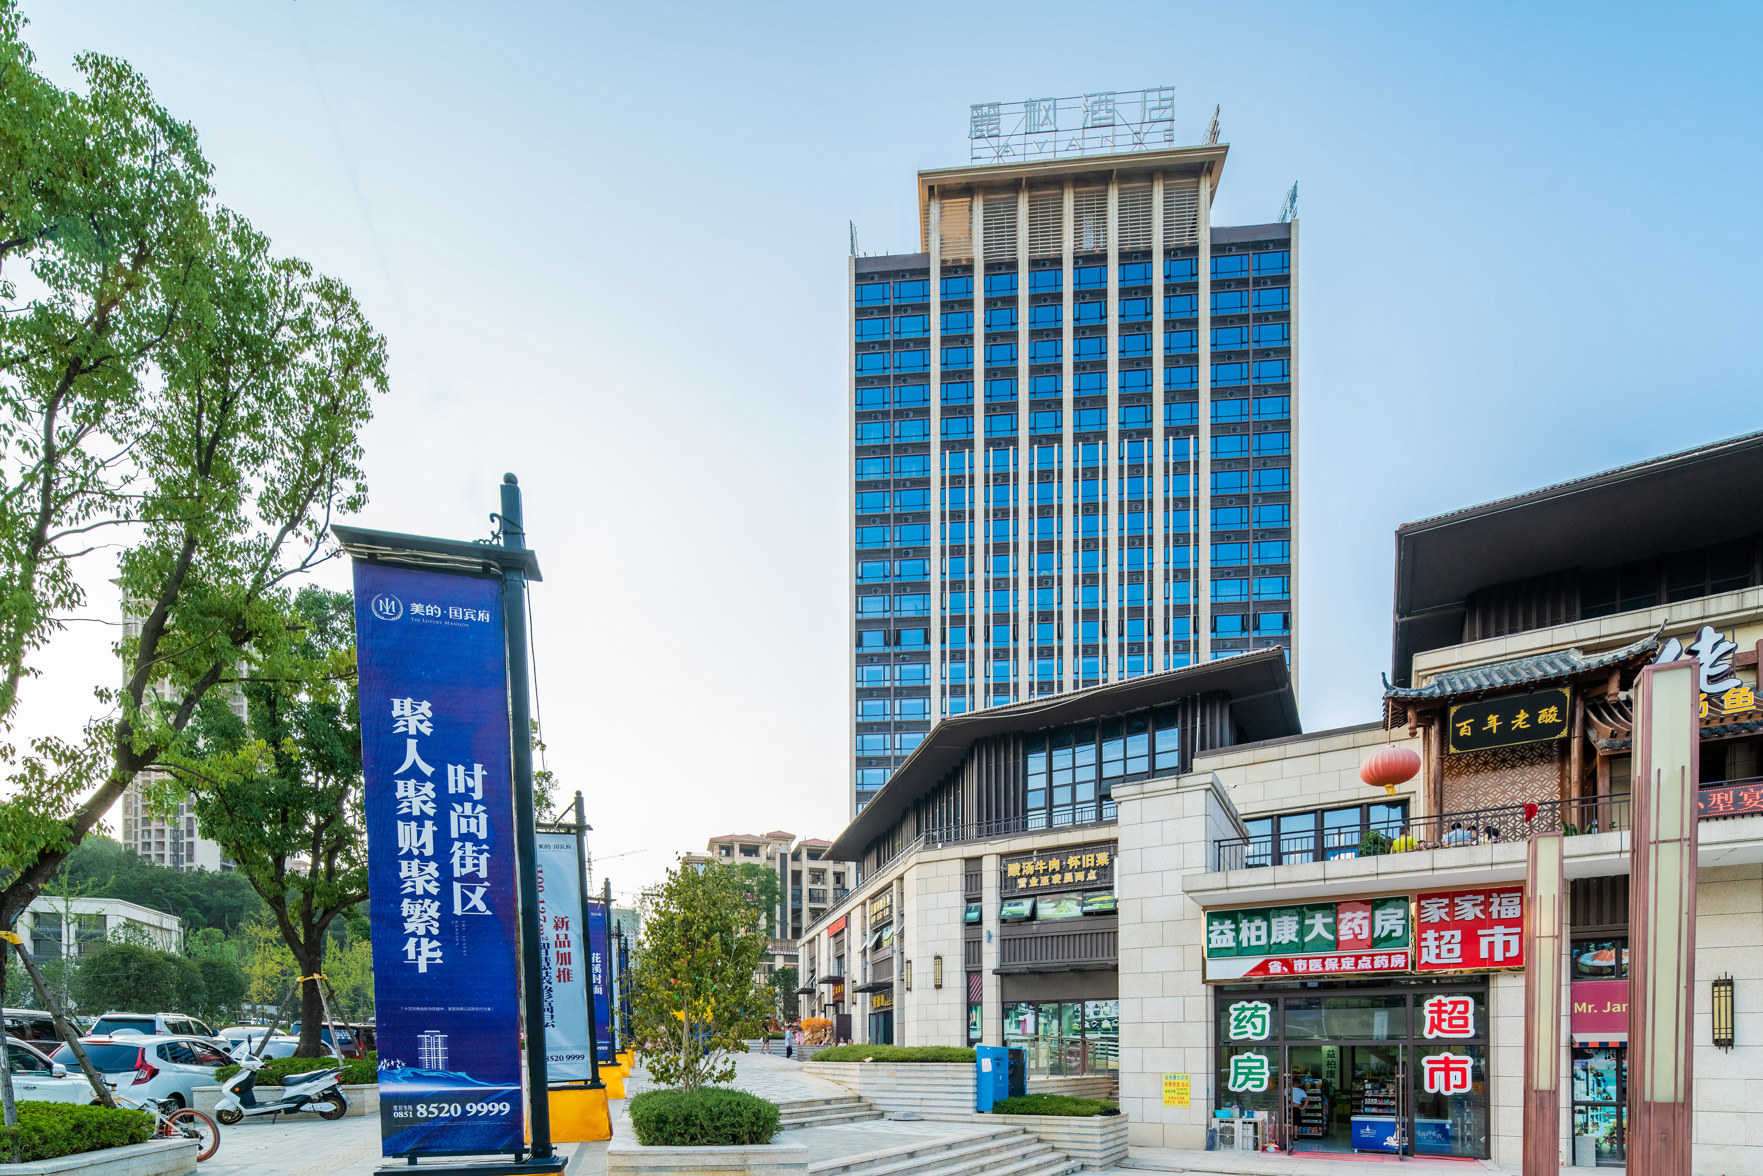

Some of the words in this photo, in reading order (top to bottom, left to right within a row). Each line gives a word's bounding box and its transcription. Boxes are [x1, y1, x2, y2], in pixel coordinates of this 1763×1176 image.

[410, 603, 490, 623] 美的·国宾府
[1456, 705, 1562, 736] 百年老酸
[1699, 788, 1763, 813] 型宴
[390, 697, 443, 973] 聚人聚财聚繁华
[447, 763, 492, 916] 时尚街区
[1008, 859, 1060, 877] 酸汤牛肉
[1067, 852, 1110, 869] 怀旧菜
[1420, 893, 1522, 924] 家家福
[1208, 907, 1405, 949] 益柏康大药房
[553, 916, 573, 983] 新品加推
[1420, 925, 1521, 965] 超市
[1268, 955, 1406, 975] 省、市医保定点药房
[1574, 1002, 1597, 1013] Mr.
[416, 1103, 461, 1117] 8520
[465, 1102, 510, 1116] 9999
